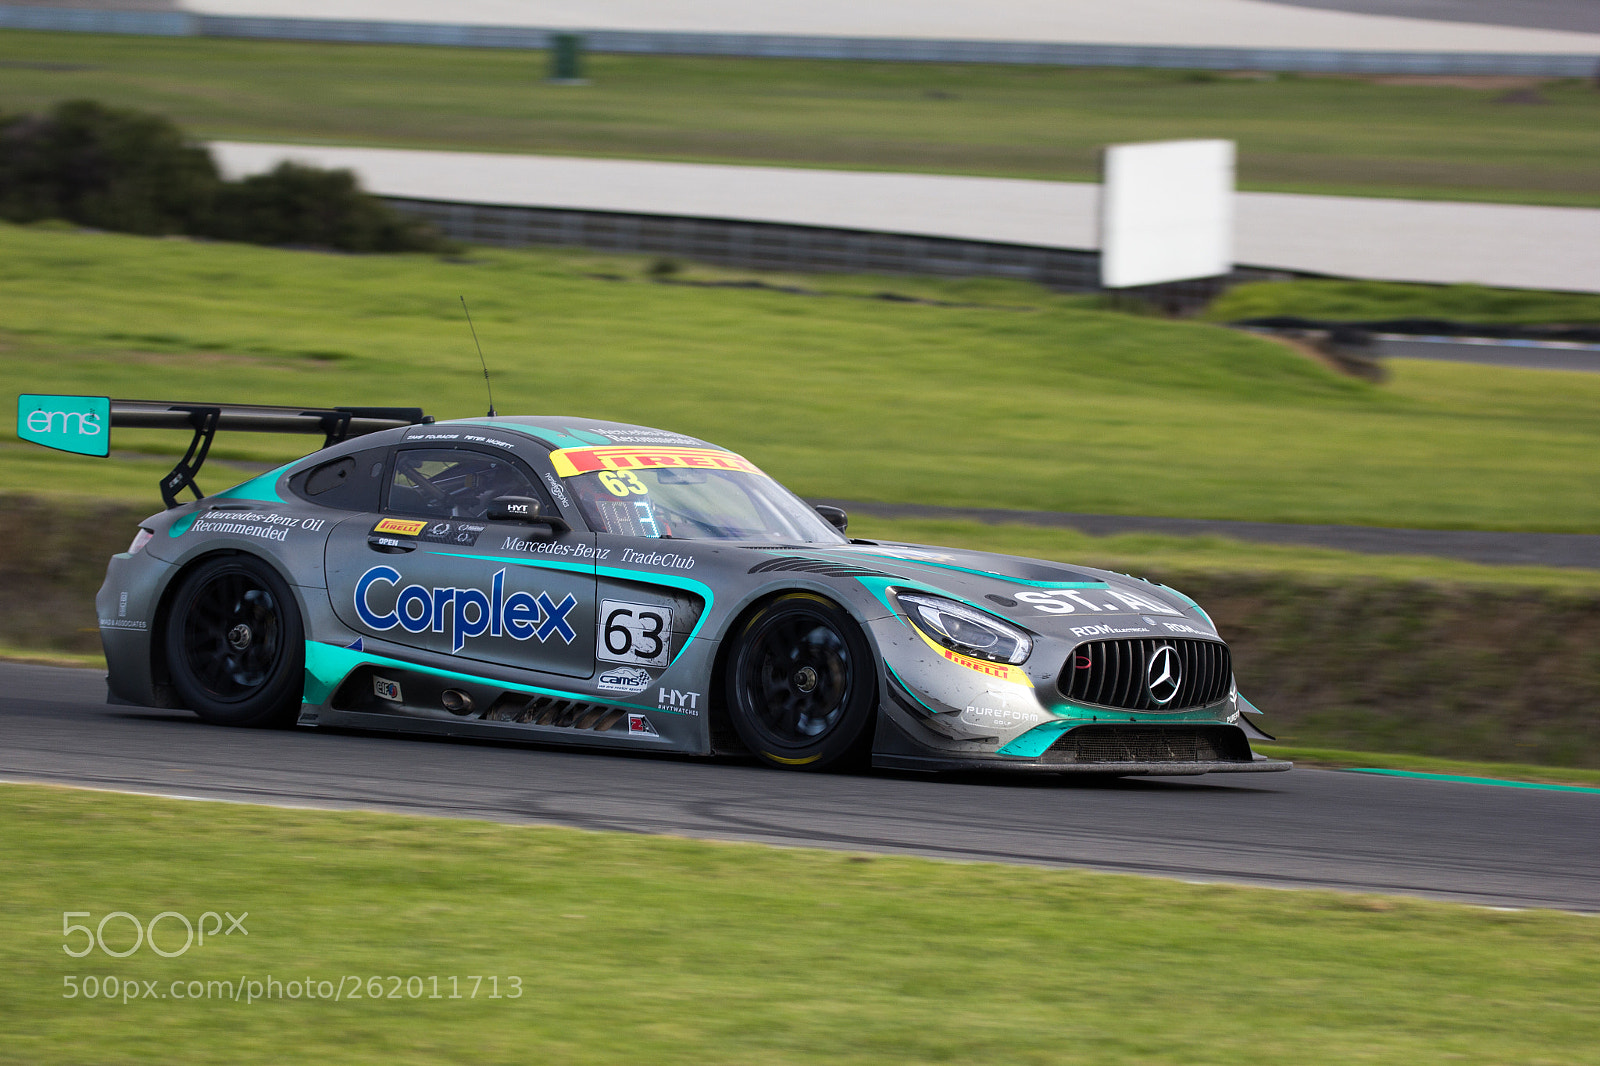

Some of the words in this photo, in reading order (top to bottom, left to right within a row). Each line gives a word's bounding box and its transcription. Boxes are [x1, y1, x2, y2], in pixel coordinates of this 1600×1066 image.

[27, 410, 101, 435] ems
[598, 470, 649, 497] 63
[507, 504, 528, 512] HYT
[190, 519, 289, 542] Recommended
[201, 511, 299, 527] Mercedes-Benz
[300, 518, 325, 532] Oil
[380, 521, 421, 532] PIRELLI
[378, 538, 399, 546] OPEN
[500, 536, 610, 560] Mercedes-Benz
[620, 547, 696, 570] TradeClub
[353, 565, 578, 655] Corplex
[604, 608, 664, 659] 63
[1069, 624, 1116, 637] RDM
[1162, 622, 1199, 634] RDM
[944, 649, 1009, 679] PIRELLI
[600, 675, 640, 686] cams
[658, 687, 701, 709] HYT
[966, 706, 1038, 721] PUREFORM
